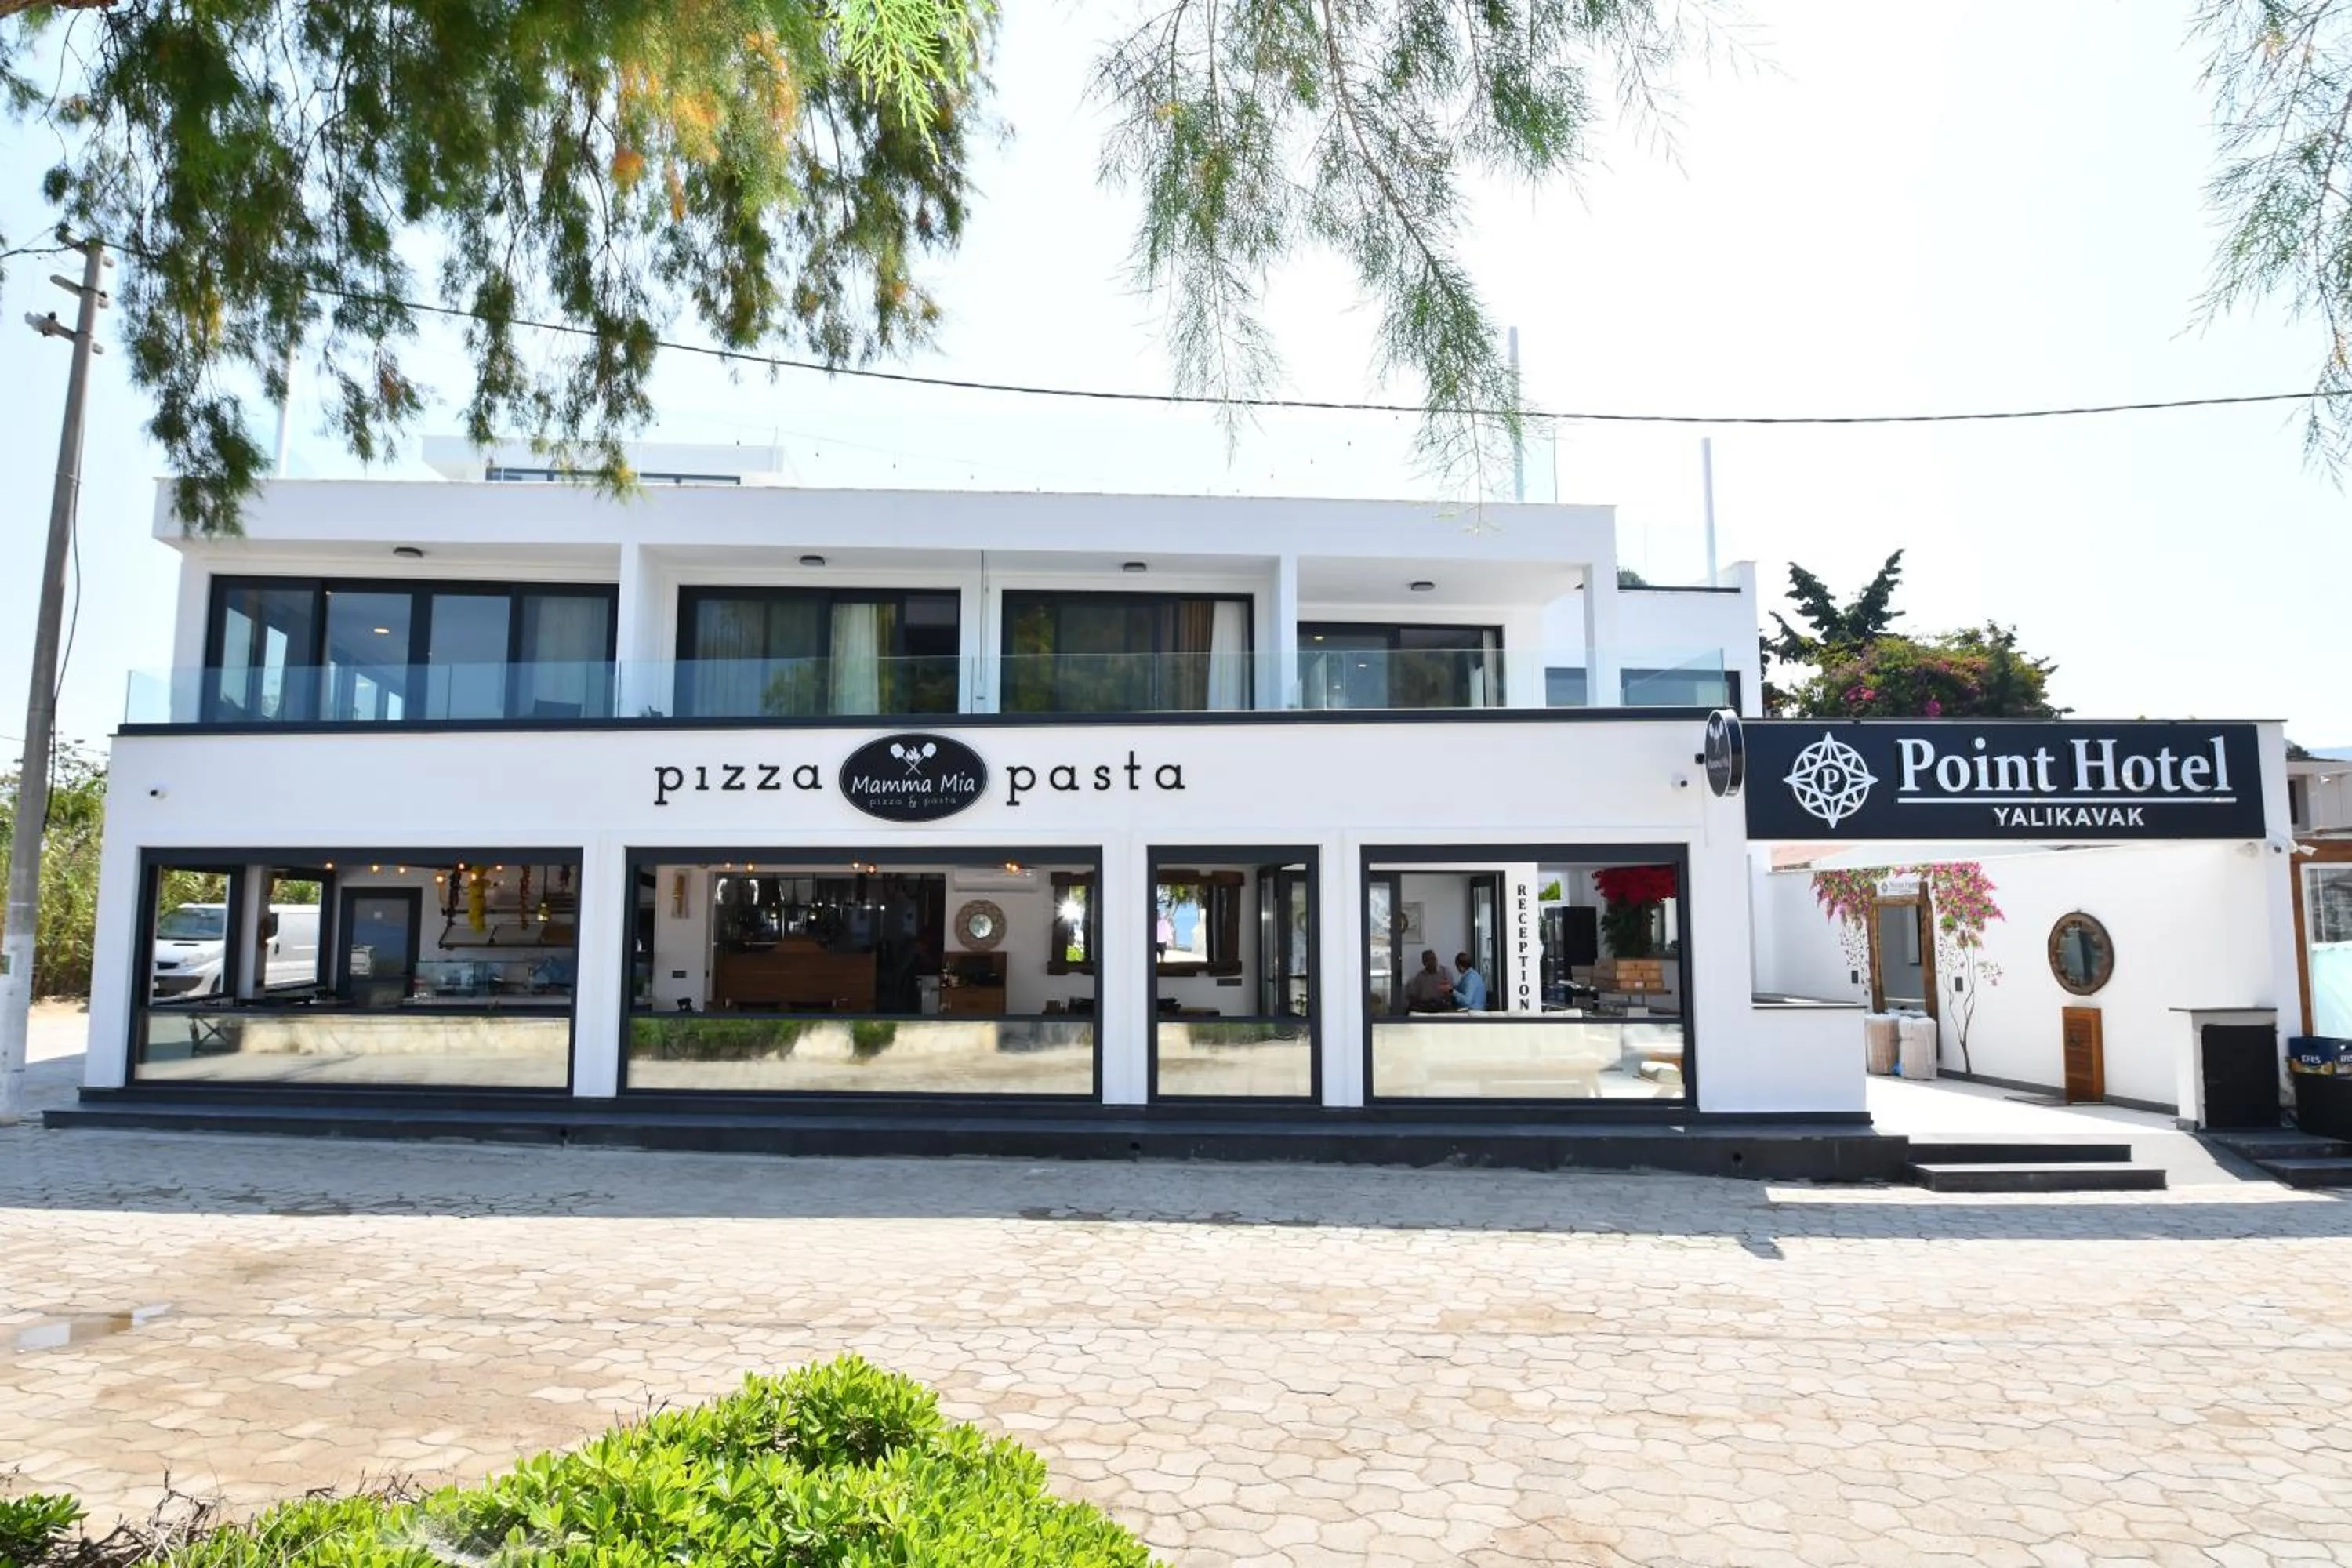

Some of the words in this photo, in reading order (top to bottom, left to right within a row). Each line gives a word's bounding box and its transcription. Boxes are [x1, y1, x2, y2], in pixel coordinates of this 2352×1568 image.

[1896, 736, 2058, 793] Point
[2069, 735, 2234, 793] Hotel
[851, 775, 932, 794] Mamma
[940, 771, 975, 793] Mia
[1005, 750, 1187, 807] pasta
[1820, 768, 1841, 793] P
[869, 797, 902, 808] pizza
[923, 796, 957, 808] pasta
[1993, 806, 2146, 827] YALIKAVAK
[1516, 884, 1530, 1011] RECEPTION
